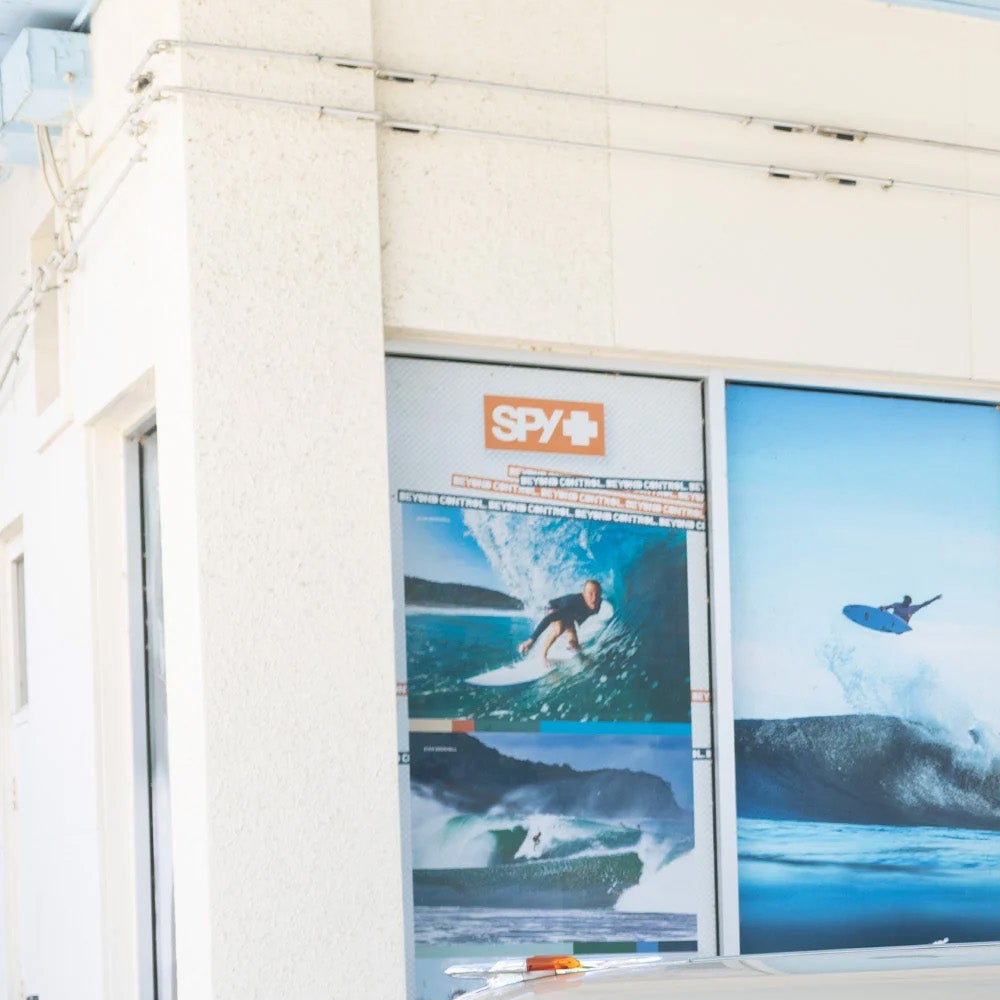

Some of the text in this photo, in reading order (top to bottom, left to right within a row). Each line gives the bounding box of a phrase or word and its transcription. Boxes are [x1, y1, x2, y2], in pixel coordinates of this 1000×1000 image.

[520, 475, 558, 488] BEYOND
[605, 479, 642, 490] BEYOND
[399, 491, 438, 505] BEYOND
[488, 501, 527, 514] BEYOND
[575, 508, 612, 521] BEYOND
[659, 517, 695, 530] BEYOND
